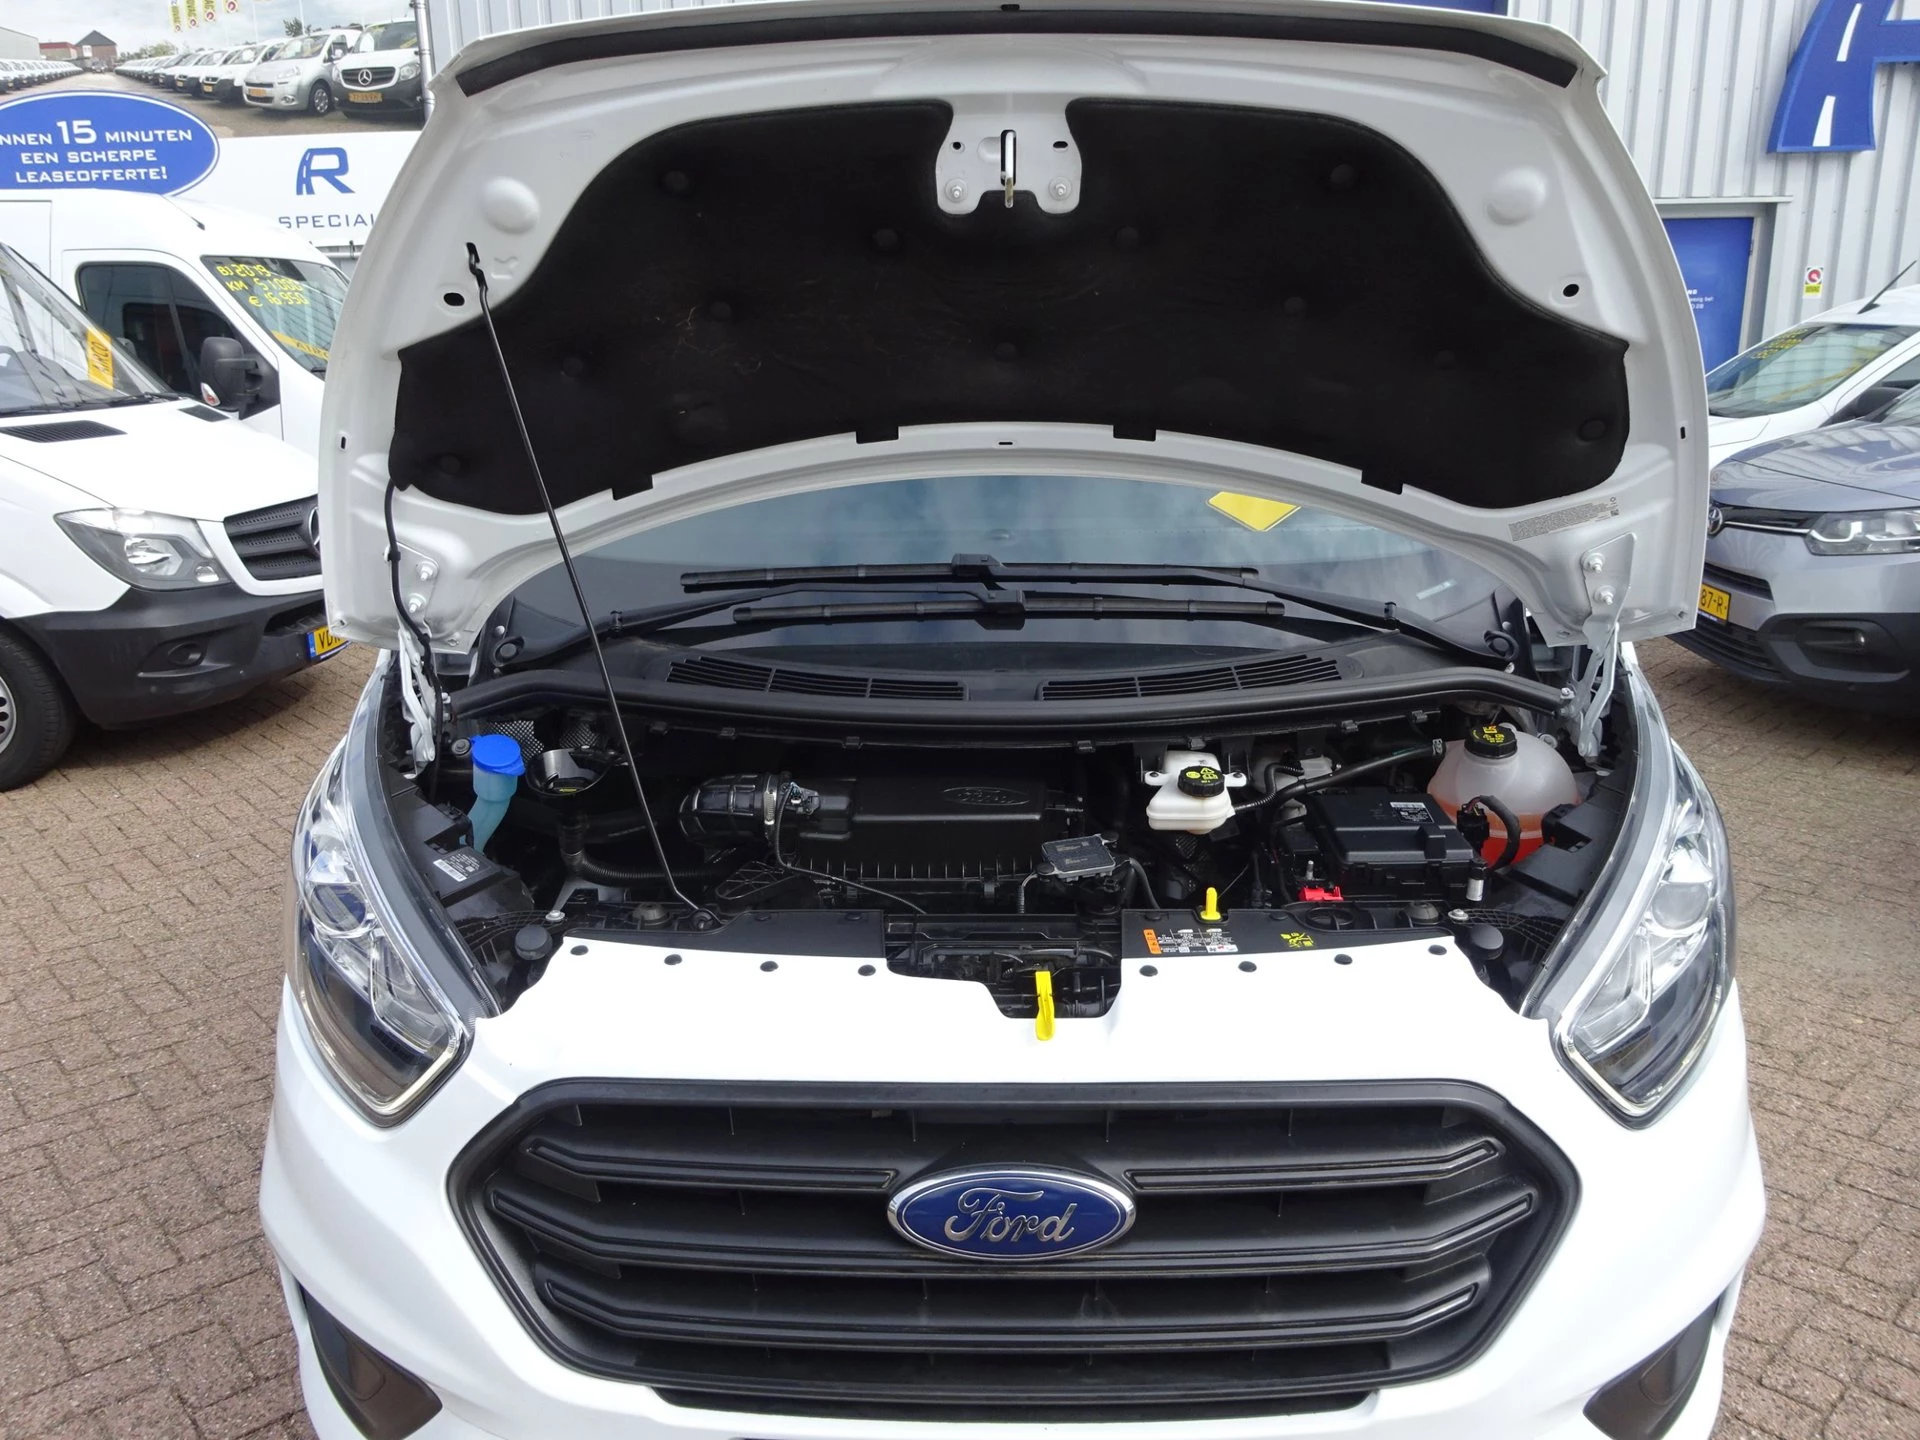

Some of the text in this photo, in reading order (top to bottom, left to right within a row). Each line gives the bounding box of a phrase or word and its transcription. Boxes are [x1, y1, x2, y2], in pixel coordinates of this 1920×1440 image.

[57, 120, 97, 144] 15
[105, 129, 192, 143] MINUTEN
[21, 150, 157, 164] EEN SCHERPE
[16, 166, 168, 183] LEASEOFFERTE!
[231, 264, 271, 277] 2019
[225, 281, 249, 291] KM
[248, 296, 263, 307] €
[944, 1187, 1078, 1242] Ford
